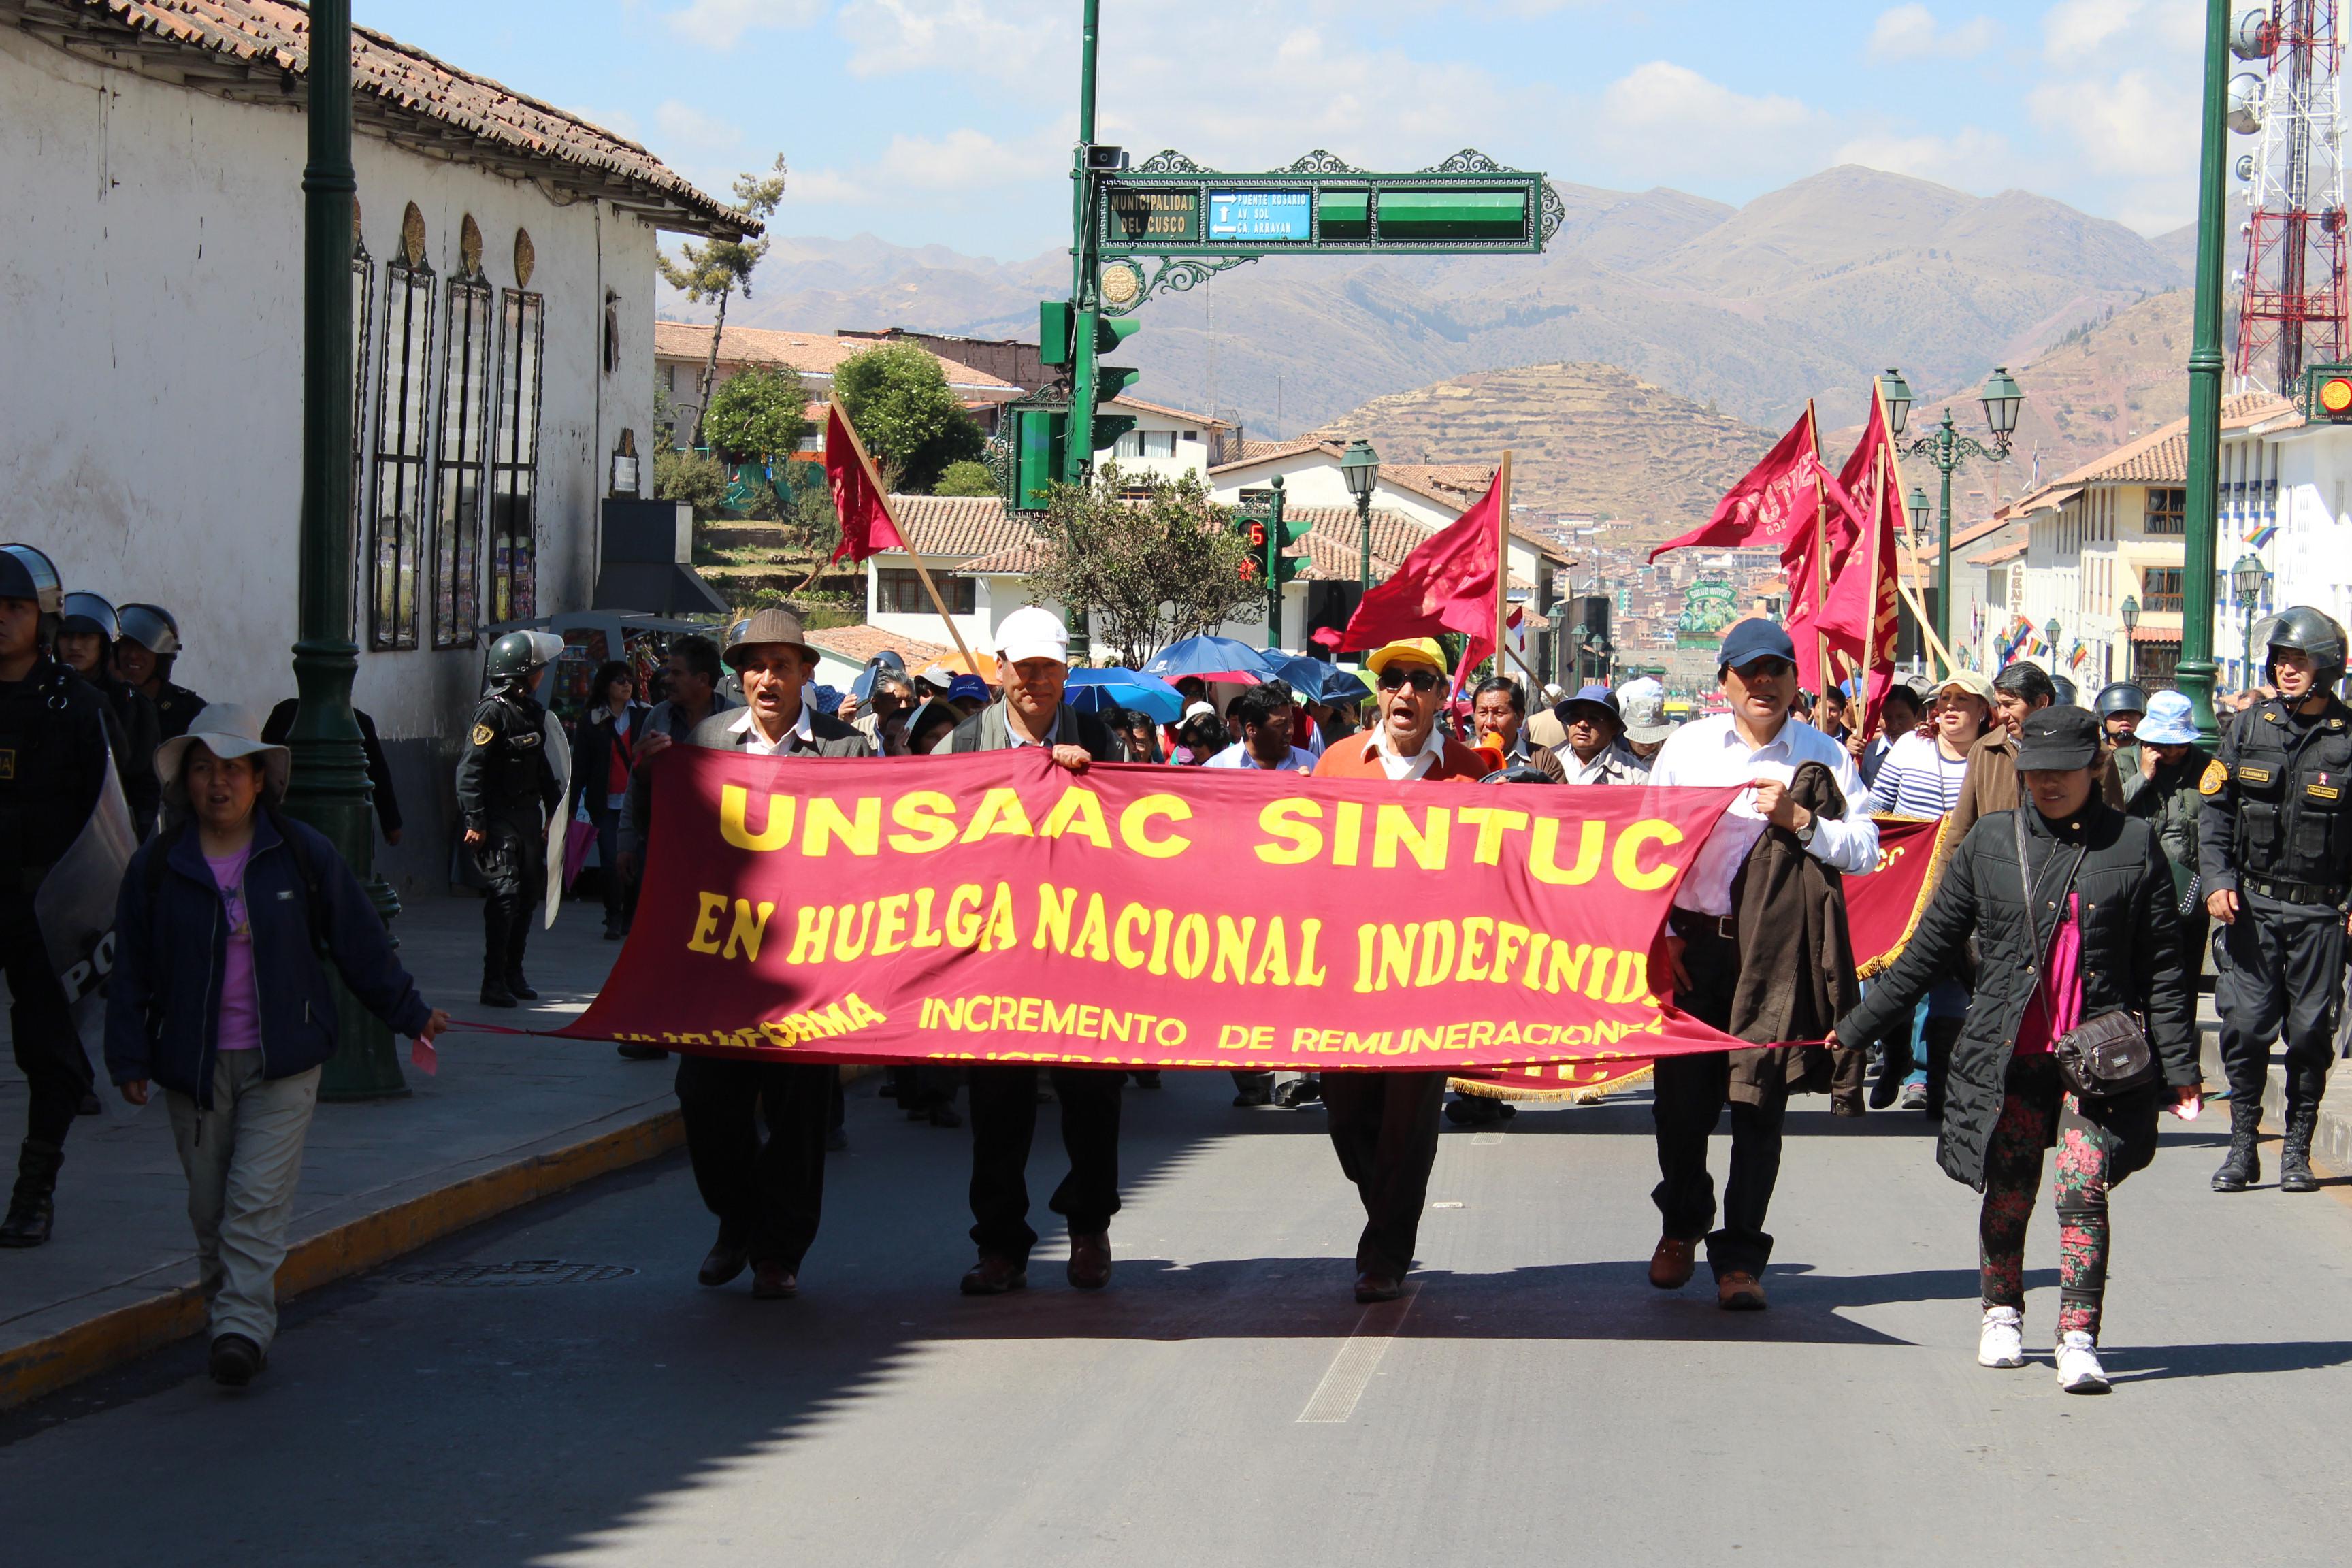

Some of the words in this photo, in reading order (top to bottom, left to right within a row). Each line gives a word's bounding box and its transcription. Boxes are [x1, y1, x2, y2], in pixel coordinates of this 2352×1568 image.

[1111, 194, 1196, 211] MUNICIPALIDAD
[1238, 194, 1269, 206] PUENTE
[1272, 194, 1307, 206] ROSARIO
[1254, 208, 1269, 220] SOL
[1121, 216, 1141, 233] DEL
[1148, 216, 1186, 233] CUSCO
[1254, 222, 1292, 234] ARRAYAN
[1689, 587, 1709, 600] SALUD
[719, 783, 1193, 858] UNSAAC
[1254, 797, 1684, 891] SINTUC
[687, 891, 776, 962] EN
[786, 881, 1018, 965] HUELGA
[1032, 882, 1327, 987] NACIONAL
[1353, 916, 1661, 1008] INDEFINID
[919, 994, 1188, 1046] INCREMENTO
[1218, 1024, 1275, 1050] DE
